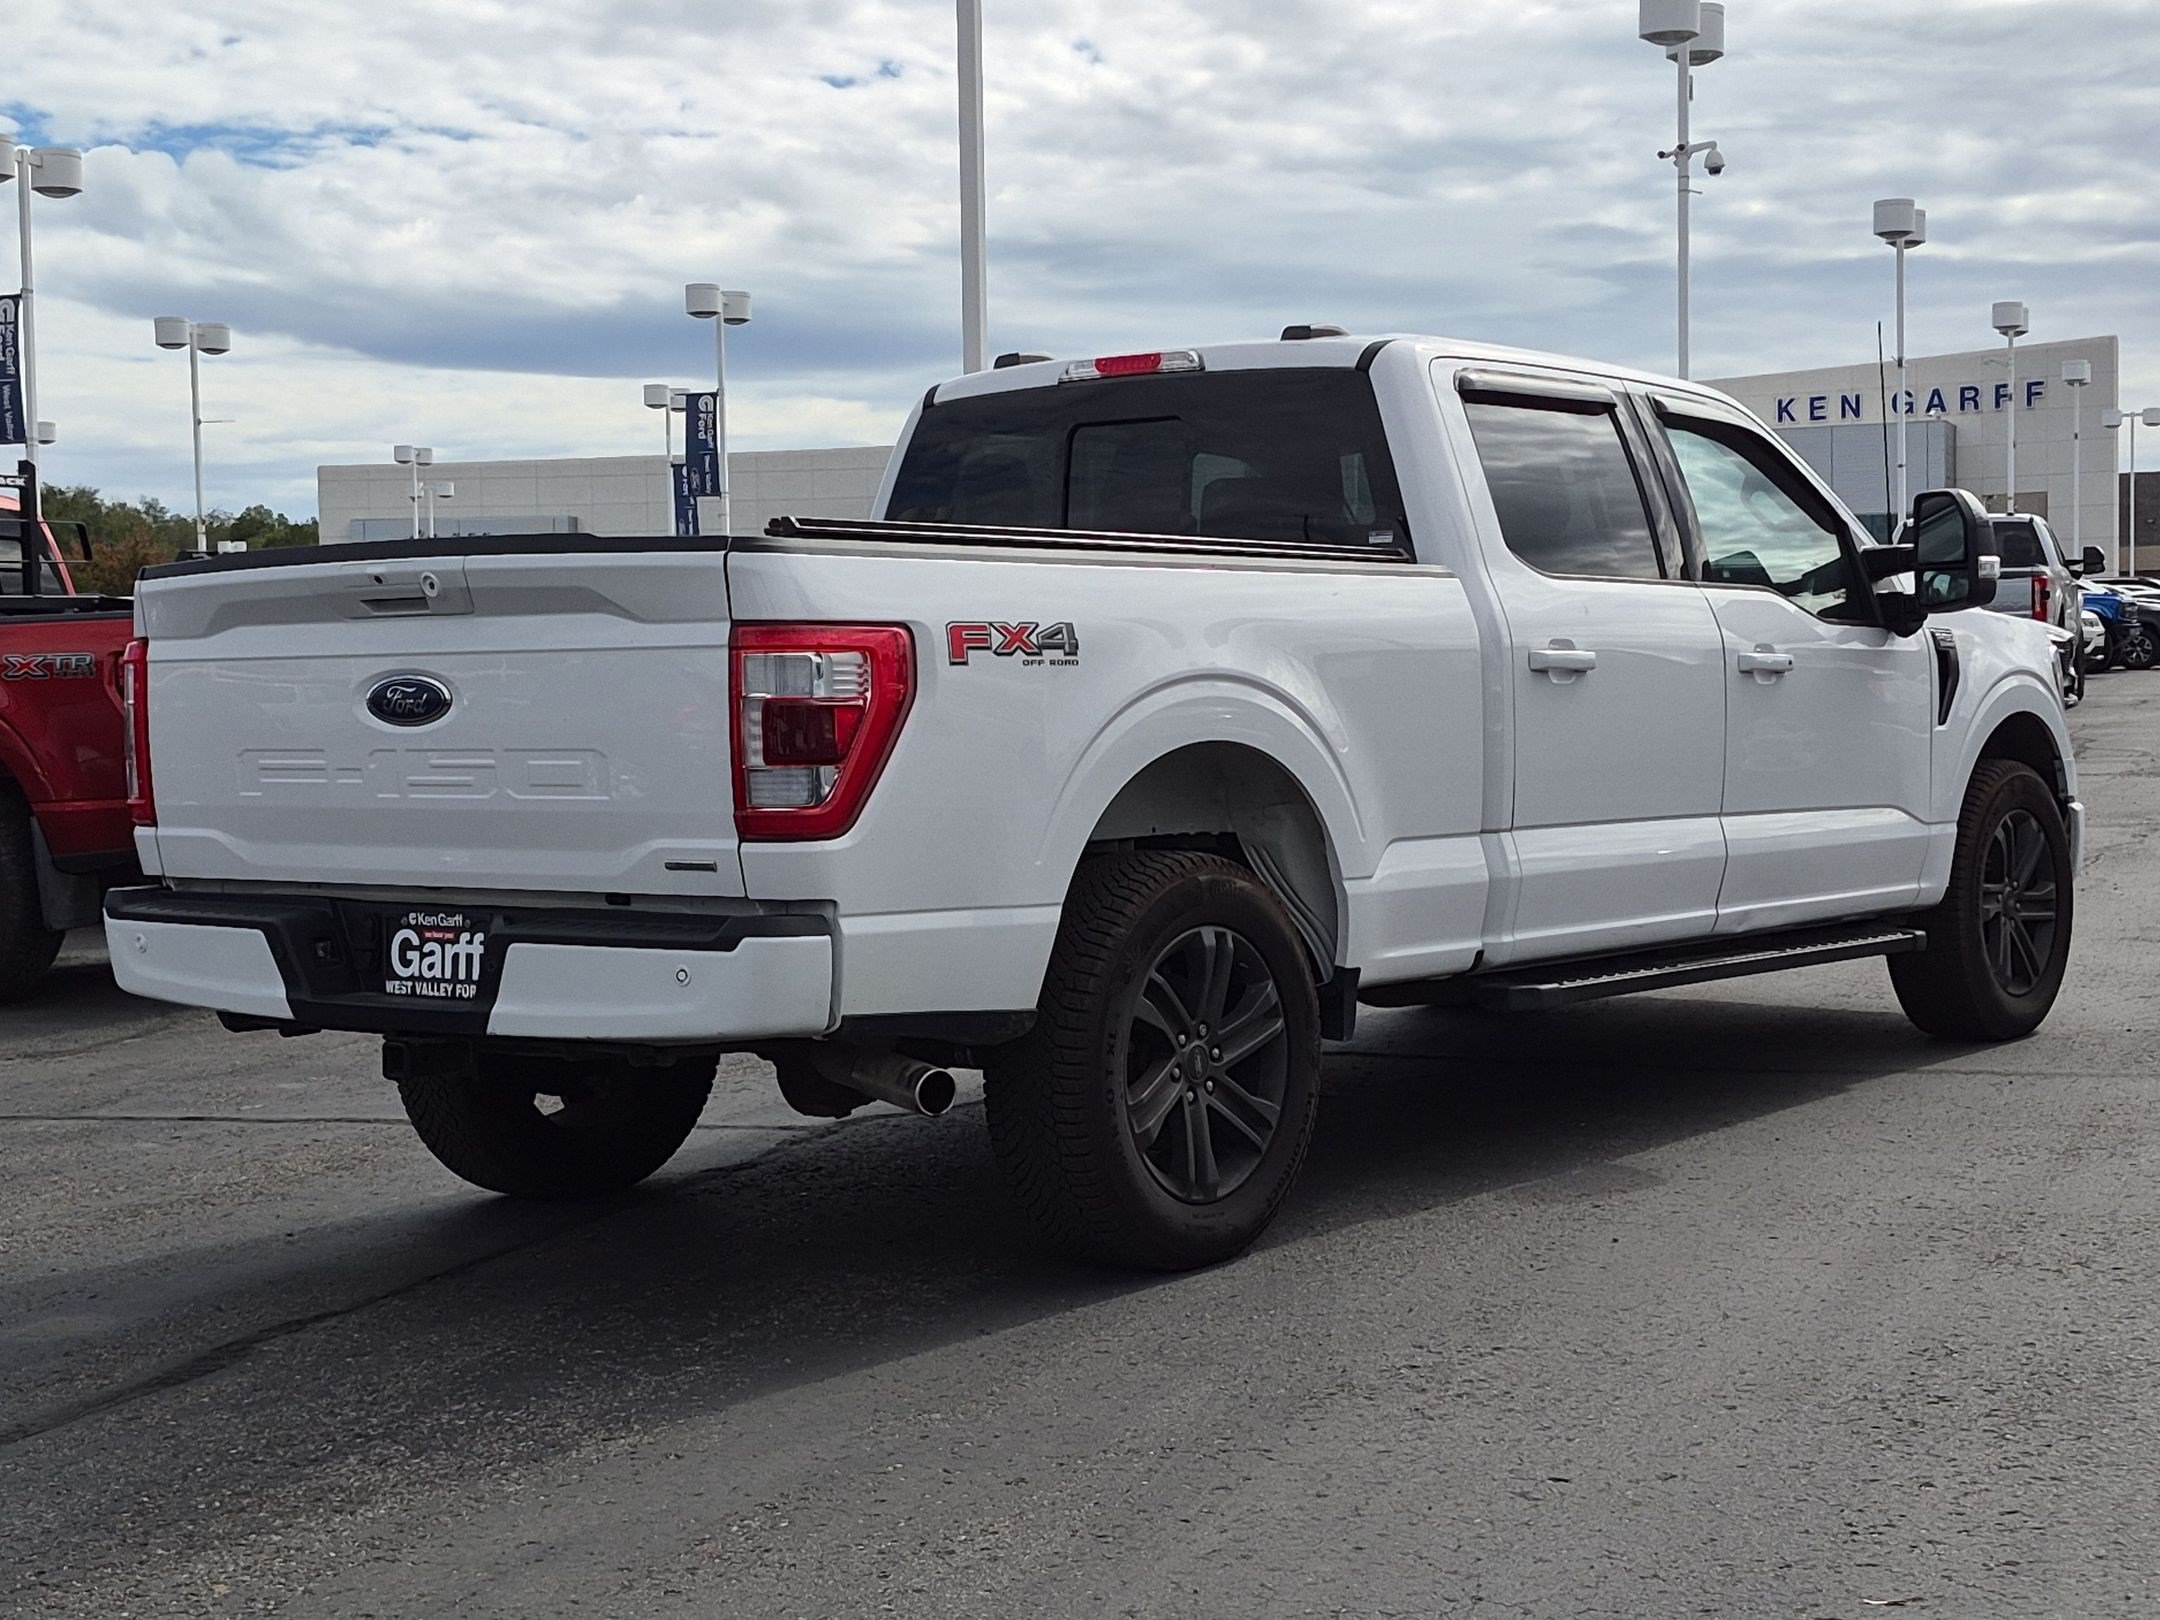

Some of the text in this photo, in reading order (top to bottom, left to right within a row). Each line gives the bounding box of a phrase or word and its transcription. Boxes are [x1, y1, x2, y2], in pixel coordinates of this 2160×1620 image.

[2, 384, 11, 410] West
[1776, 381, 2045, 423] KEN GARFF
[698, 414, 706, 439] Ford
[945, 621, 1079, 665] FX4
[4, 653, 93, 678] XTR
[383, 685, 428, 713] Ford
[236, 748, 610, 800] F-150
[391, 928, 484, 981] Garff
[385, 980, 477, 998] WEST VALLEY FOR
